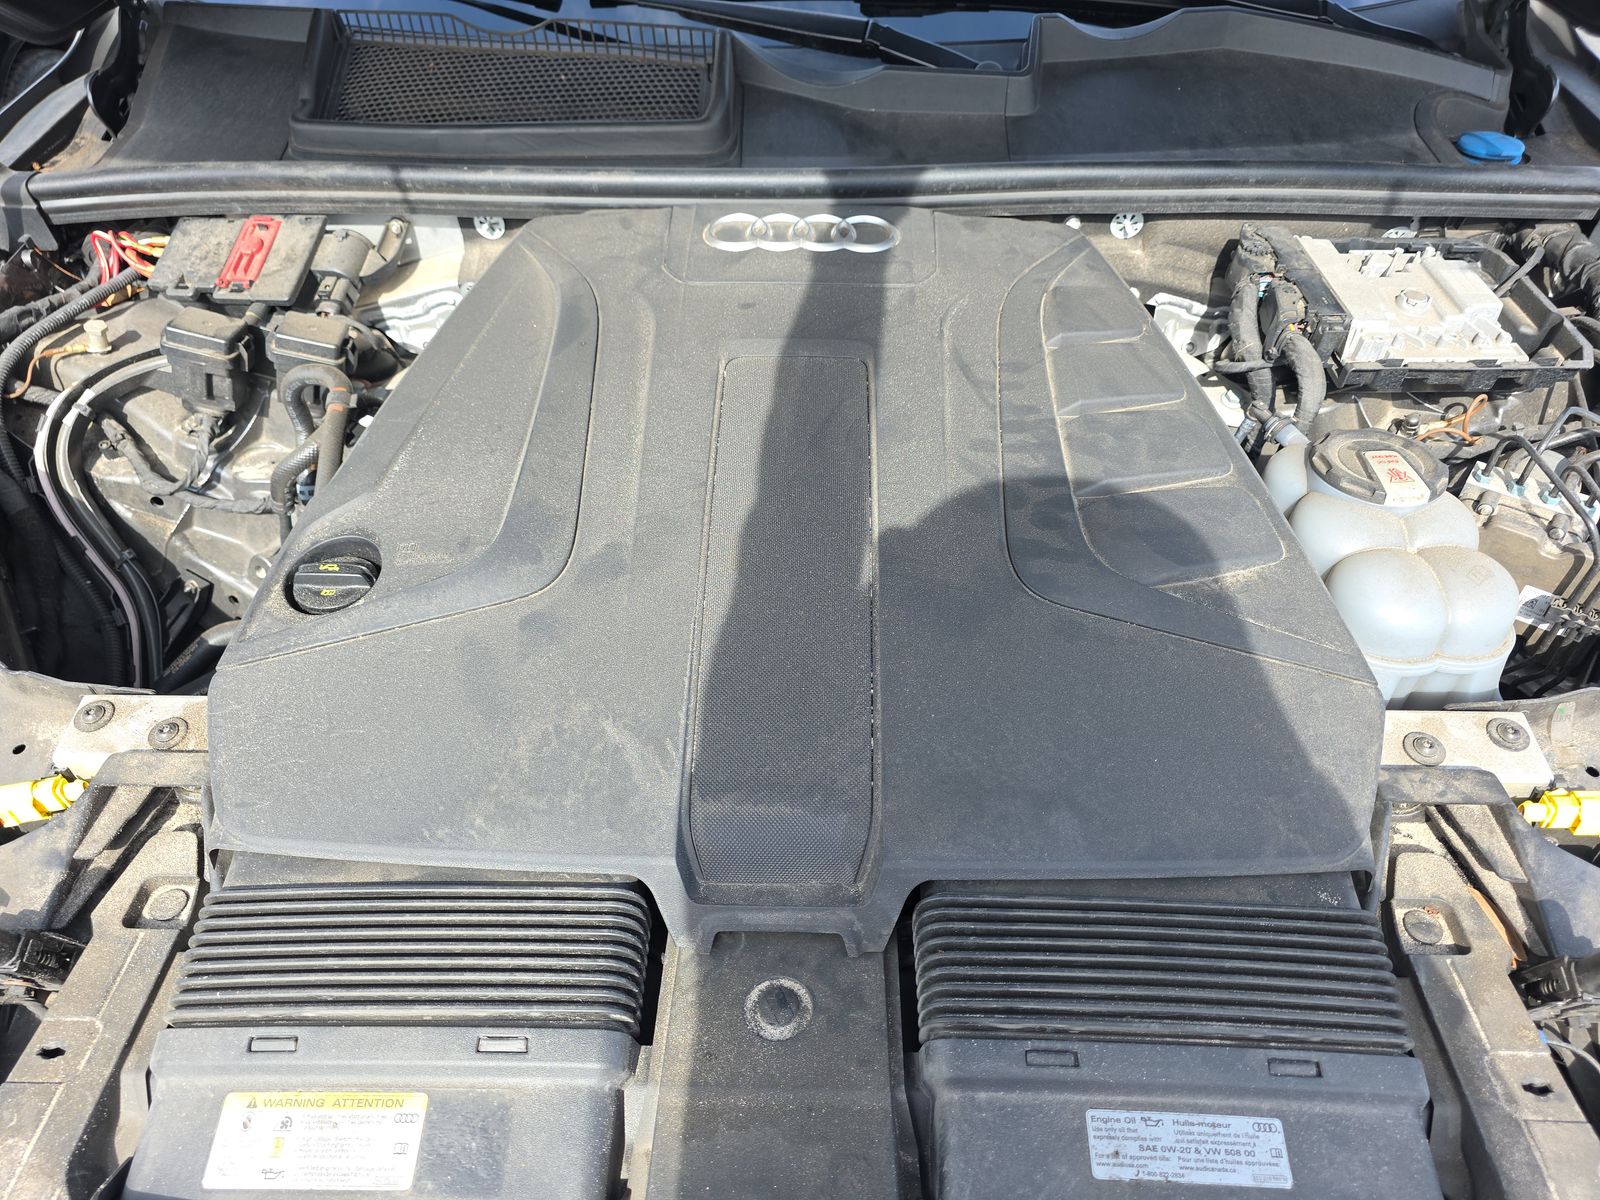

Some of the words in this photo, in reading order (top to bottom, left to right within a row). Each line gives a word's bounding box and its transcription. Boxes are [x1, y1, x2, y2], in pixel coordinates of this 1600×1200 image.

[263, 1098, 326, 1108] WARNING
[332, 1098, 405, 1108] ATTENTION
[1091, 1115, 1121, 1124] Engine
[1138, 1144, 1158, 1152] SAE
[1160, 1145, 1191, 1154] 0W-20
[1194, 1147, 1202, 1155] &
[1205, 1147, 1221, 1155] VW
[1224, 1149, 1242, 1157] 508
